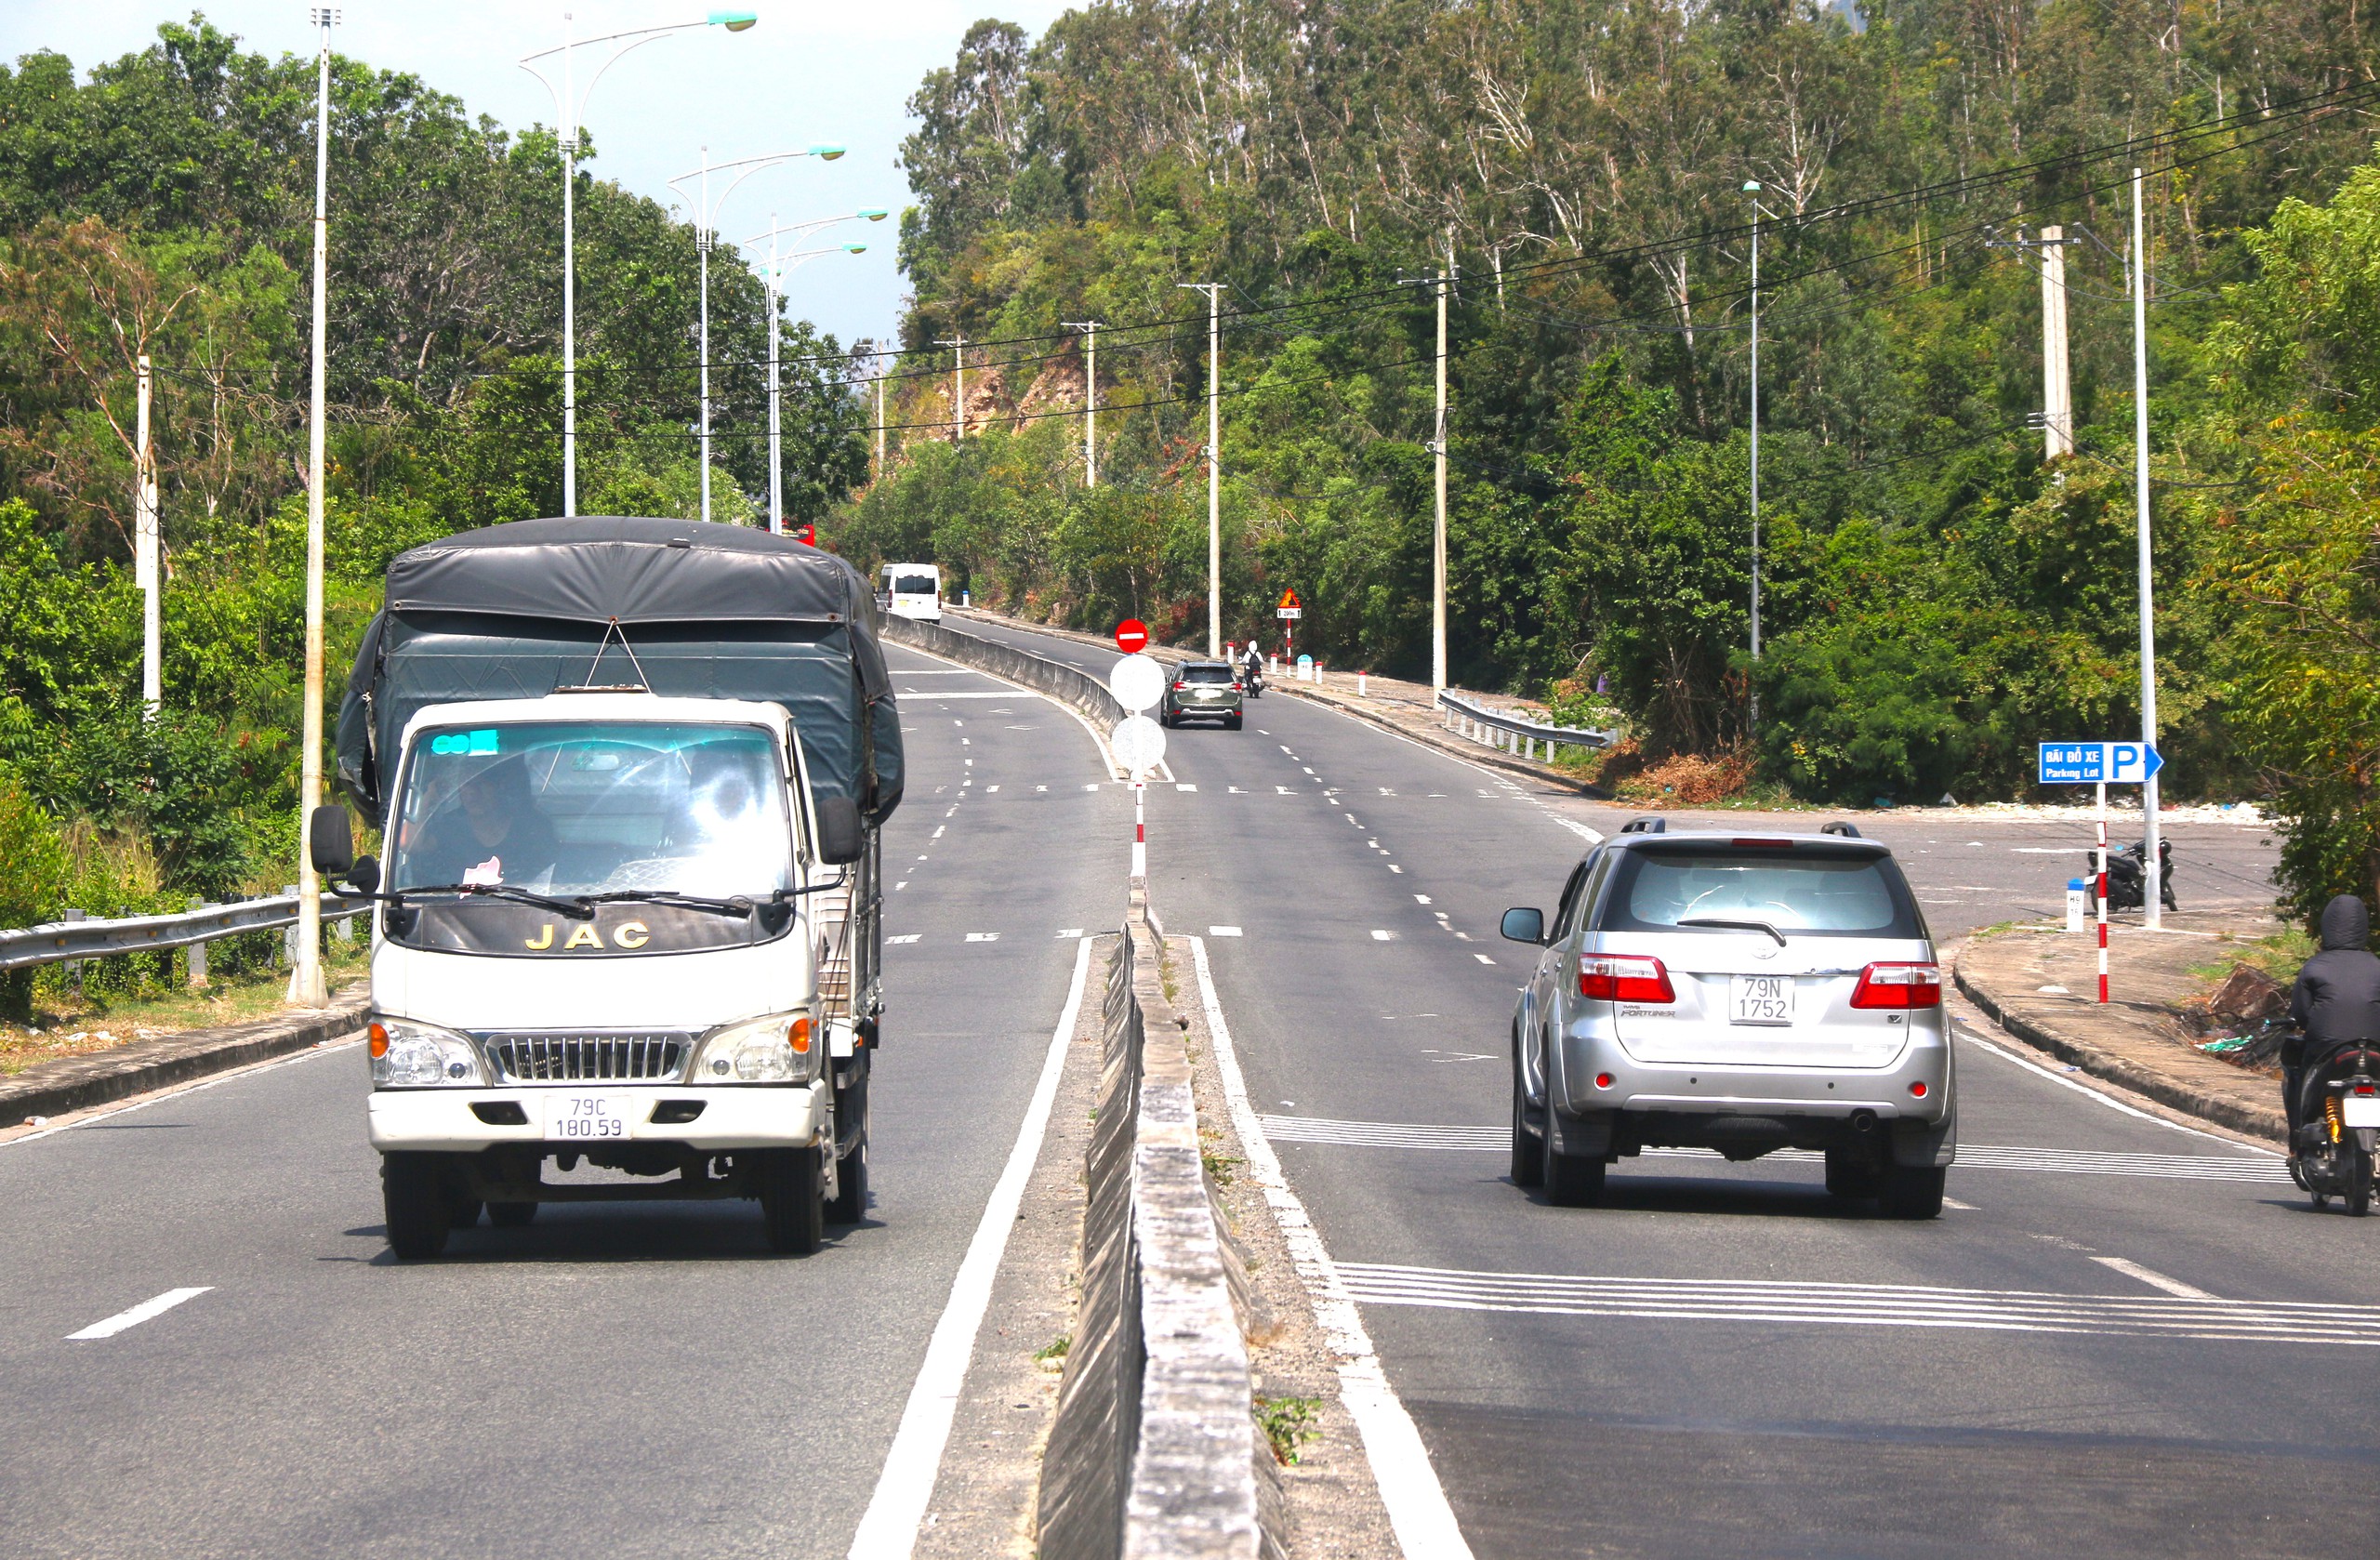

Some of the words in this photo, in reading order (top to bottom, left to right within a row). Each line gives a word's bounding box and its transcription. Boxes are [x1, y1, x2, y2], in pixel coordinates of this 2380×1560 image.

[2067, 746, 2082, 763] ĐỖ
[2085, 750, 2100, 763] XE
[2112, 745, 2138, 779] P
[2045, 768, 2081, 780] Parking
[2083, 767, 2099, 778] Lot
[524, 921, 651, 951] JAC
[1744, 978, 1781, 998] 79N
[1739, 998, 1787, 1019] 1752
[570, 1099, 606, 1116] 79C
[557, 1118, 622, 1136] 180.59
